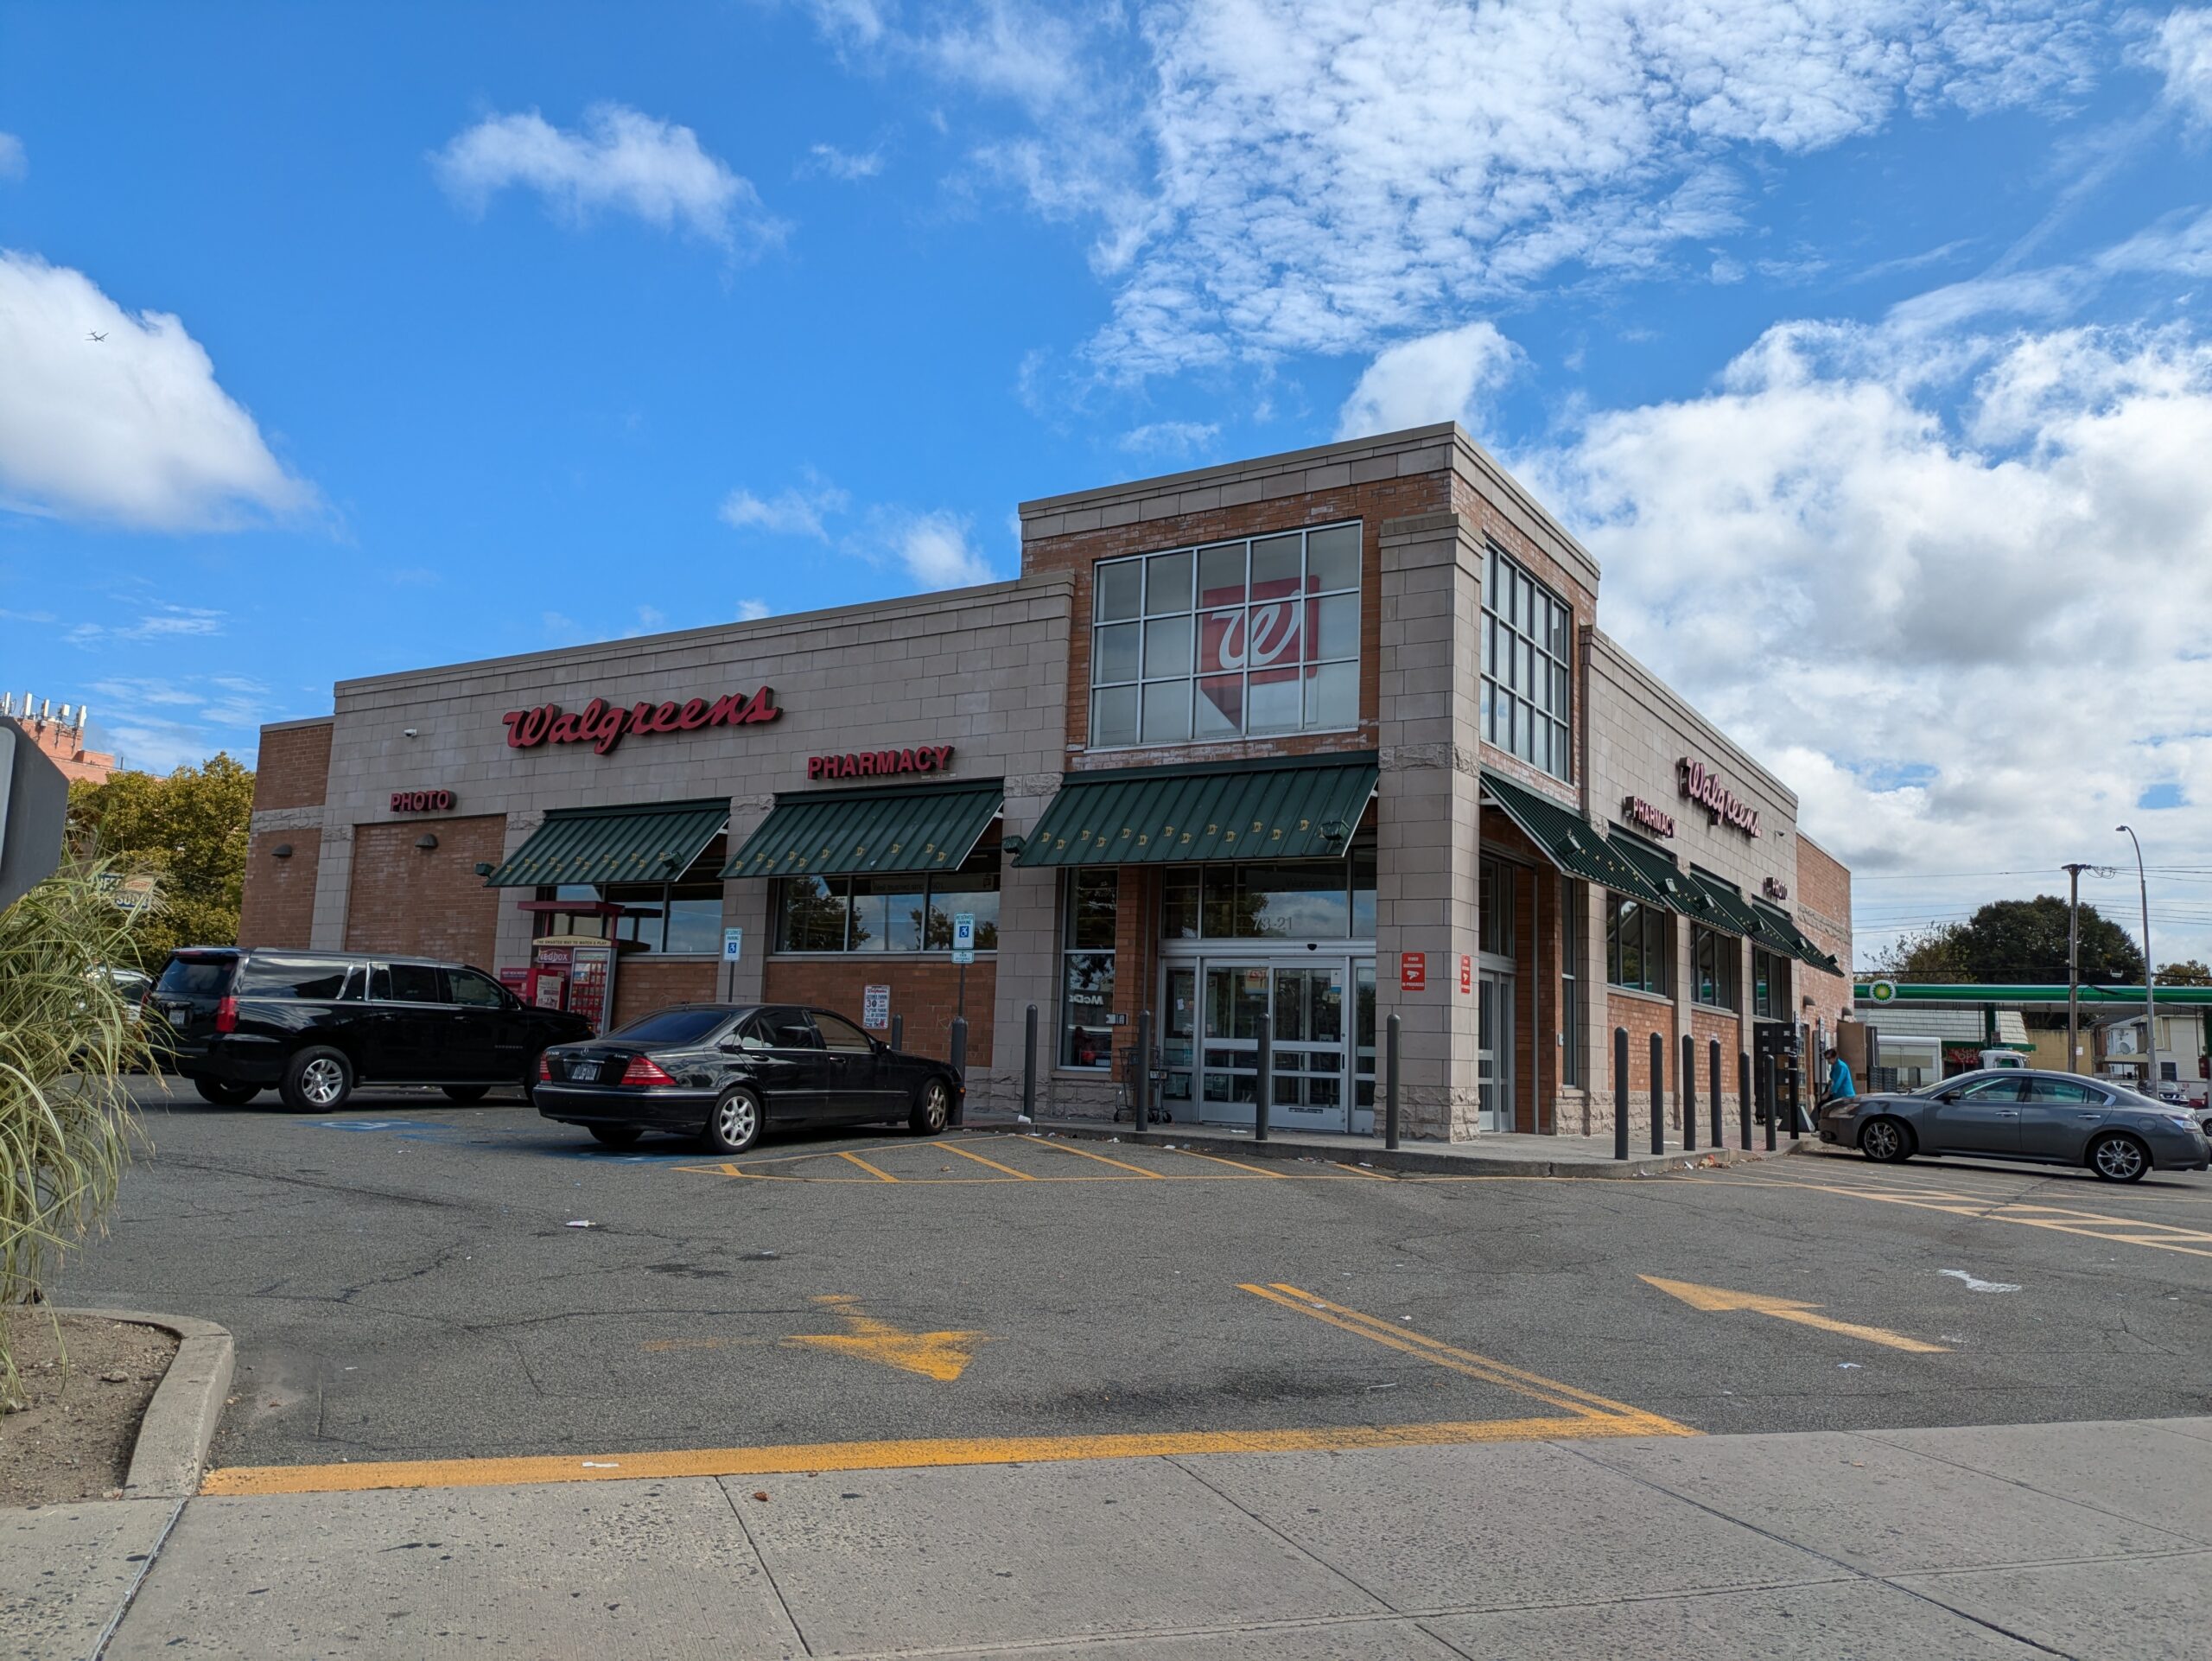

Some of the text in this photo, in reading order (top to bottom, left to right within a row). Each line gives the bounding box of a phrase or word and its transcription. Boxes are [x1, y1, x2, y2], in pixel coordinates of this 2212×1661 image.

[502, 685, 781, 754] Walgreens
[808, 745, 953, 780] PHARMACY
[390, 790, 454, 811] PHOTO
[1685, 756, 1763, 837] Walgreens
[1631, 796, 1676, 838] PHARMACY
[1771, 878, 1788, 901] PHOTO
[1253, 916, 1293, 931] 73-21
[540, 951, 568, 963] redbox
[867, 999, 877, 1008] 30
